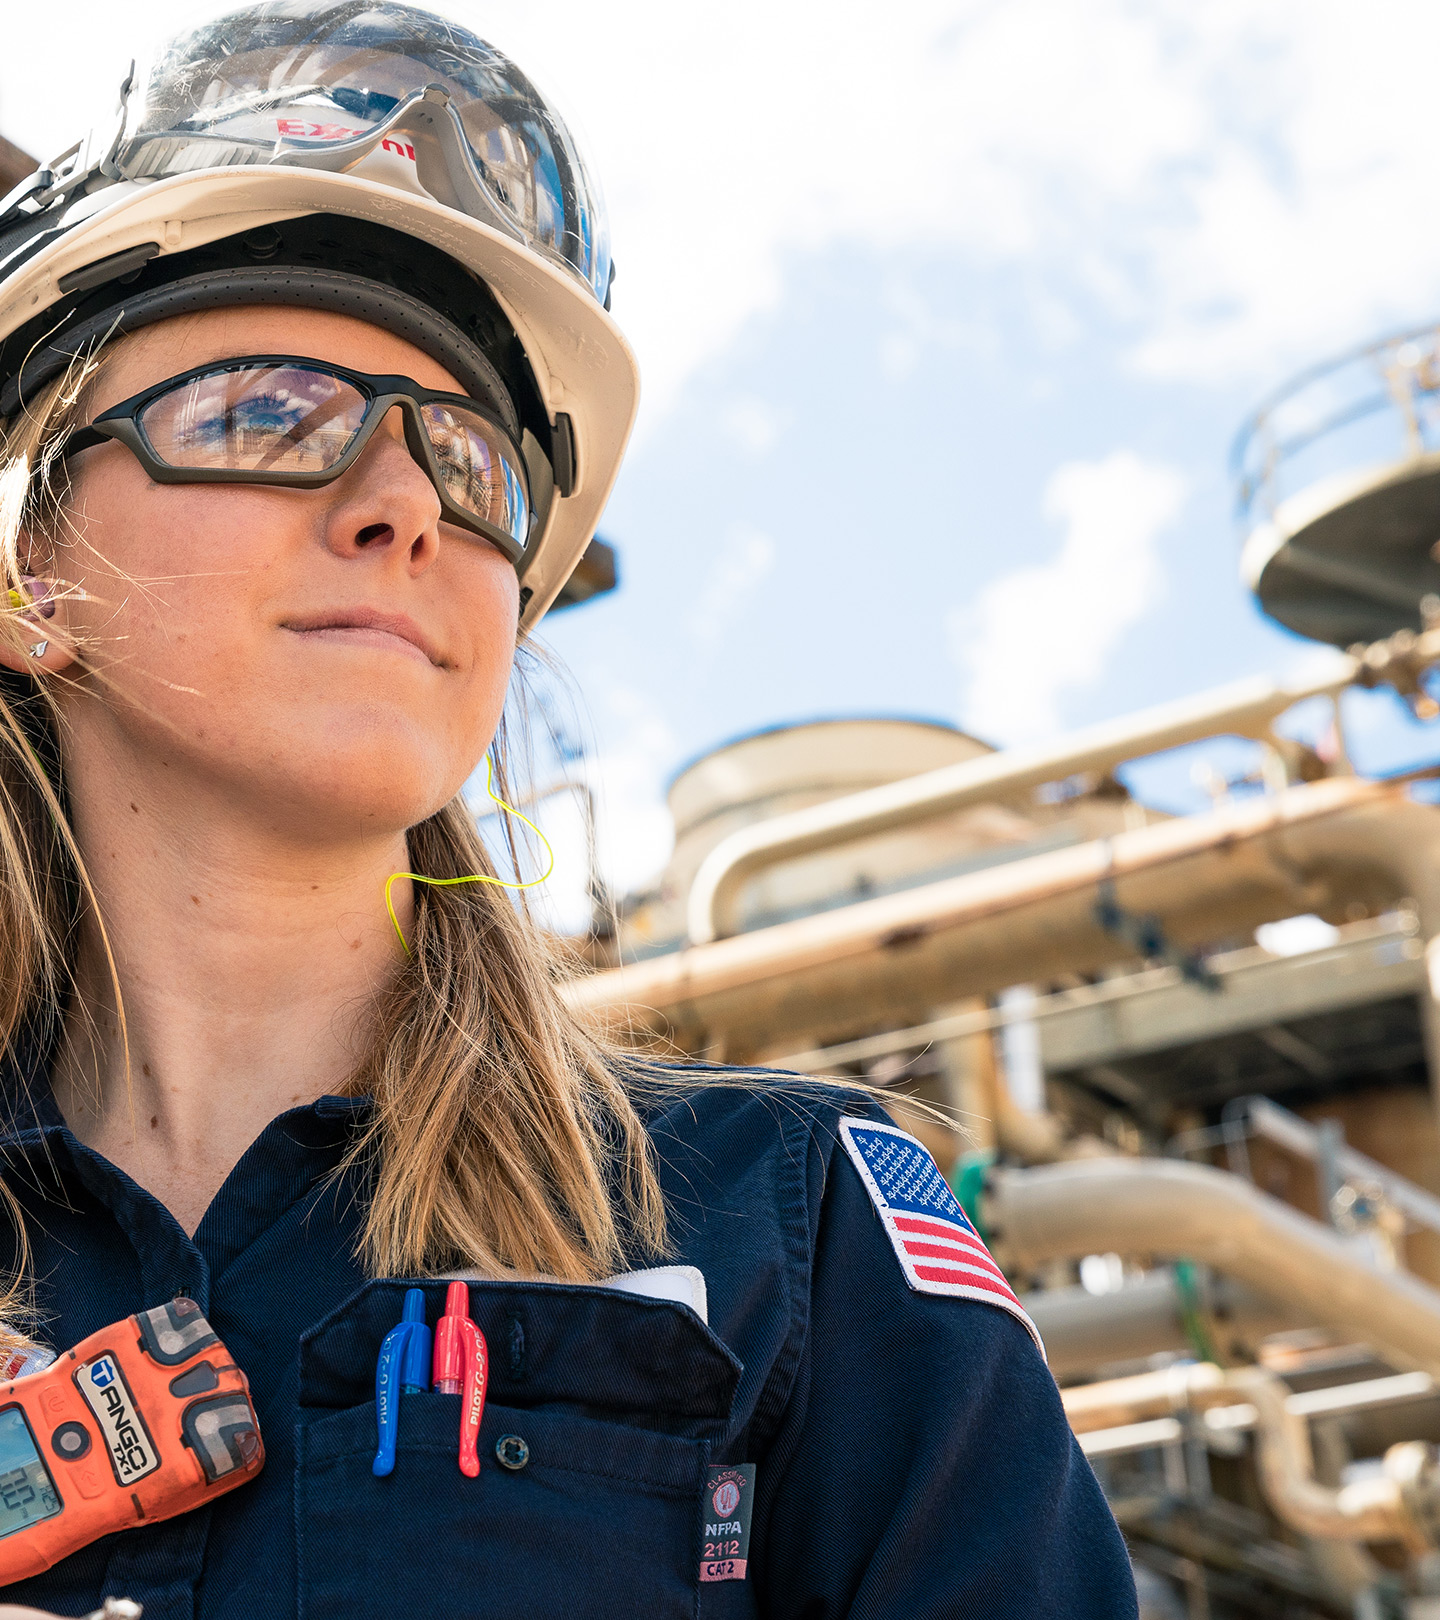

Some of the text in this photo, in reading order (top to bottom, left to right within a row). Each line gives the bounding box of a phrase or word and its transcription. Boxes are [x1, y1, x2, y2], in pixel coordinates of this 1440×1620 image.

[380, 1354, 390, 1385] G-2
[475, 1351, 486, 1386] G-2
[91, 1359, 148, 1471] TANGO
[380, 1390, 388, 1425] PILOT
[470, 1387, 483, 1426] PILOT
[113, 1442, 133, 1477] TX1
[707, 1470, 747, 1490] CLASSIFIED
[720, 1487, 733, 1509] UL
[705, 1521, 742, 1536] NFPA
[703, 1540, 740, 1558] 2112
[707, 1561, 735, 1576] CAT 2
